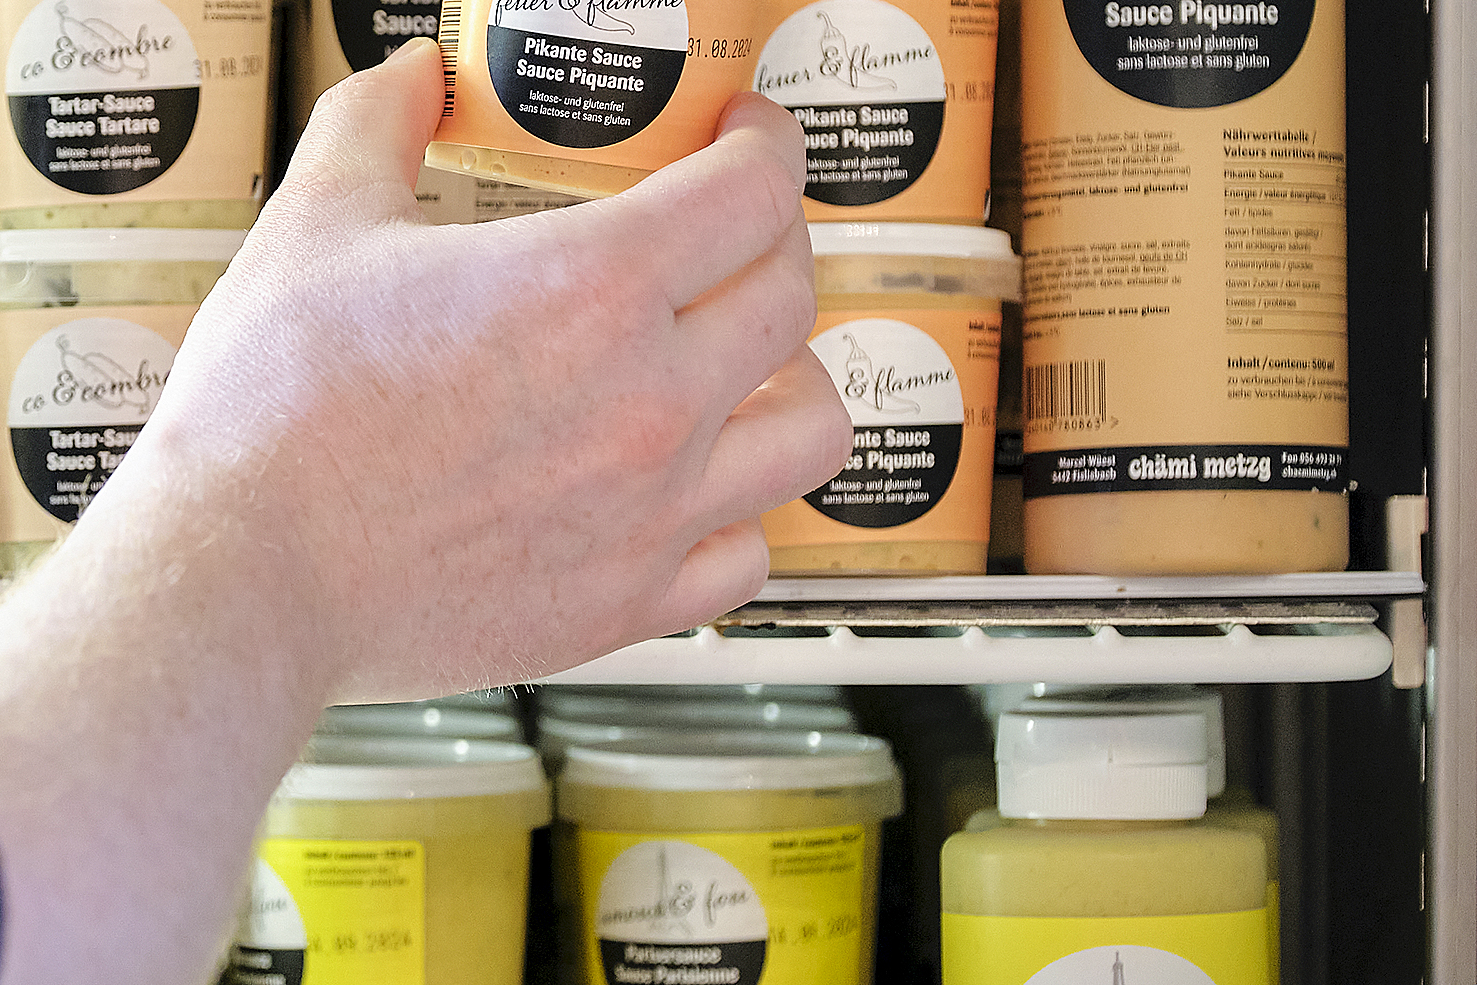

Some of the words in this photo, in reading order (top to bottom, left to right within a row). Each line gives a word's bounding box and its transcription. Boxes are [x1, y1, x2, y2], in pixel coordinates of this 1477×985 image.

[372, 10, 438, 35] Sauce
[1105, 1, 1174, 28] Sauce
[1180, 0, 1279, 31] Piquante
[51, 36, 77, 70] &
[525, 37, 586, 62] Pikante
[592, 48, 642, 68] Sauce
[688, 37, 752, 58] 31.08.2024
[1129, 36, 1175, 52] laktose-
[1177, 36, 1201, 50] und
[1204, 35, 1258, 54] glutenfrei
[756, 64, 814, 94] feuer
[819, 46, 844, 76] &
[849, 42, 934, 88] flamme
[1117, 55, 1143, 70] sans
[1146, 54, 1188, 69] lactose
[1191, 54, 1203, 67] et
[1206, 54, 1232, 67] sans
[1235, 54, 1270, 72] gluten
[516, 59, 564, 82] Sauce
[570, 66, 644, 91] Piquante
[48, 95, 155, 116] Tartar-Sauce
[529, 90, 562, 105] laktose-
[564, 96, 581, 107] und
[584, 97, 624, 113] glutenfrei
[519, 102, 538, 114] sans
[540, 105, 570, 118] lactose
[572, 111, 581, 120] et
[583, 112, 602, 123] sans
[604, 113, 631, 126] gluten
[795, 106, 856, 127] Pikante
[860, 106, 909, 124] Sauce
[46, 118, 96, 138] Sauce
[97, 117, 160, 135] Tartare
[804, 132, 838, 148] auce
[842, 128, 914, 152] Piquante
[842, 156, 859, 168] und
[861, 155, 899, 168] glutenfrei
[1224, 145, 1266, 157] Valeurs
[852, 170, 860, 181] et
[862, 169, 881, 180] sans
[883, 169, 908, 182] gluten
[52, 369, 79, 405] &
[845, 368, 868, 397] &
[874, 366, 954, 410] flamme
[49, 429, 141, 449] Tartar-Sau
[884, 429, 930, 447] Sauce
[46, 451, 96, 471] Sauce
[868, 450, 934, 473] Piquante
[1128, 454, 1196, 481] chämi
[1204, 453, 1271, 482] metzg
[866, 479, 883, 490] und
[885, 478, 922, 492] glutenfrei
[823, 494, 842, 505] sans
[844, 492, 874, 504] lactose
[876, 493, 884, 504] et
[886, 493, 904, 504] sans
[906, 492, 929, 505] gluten
